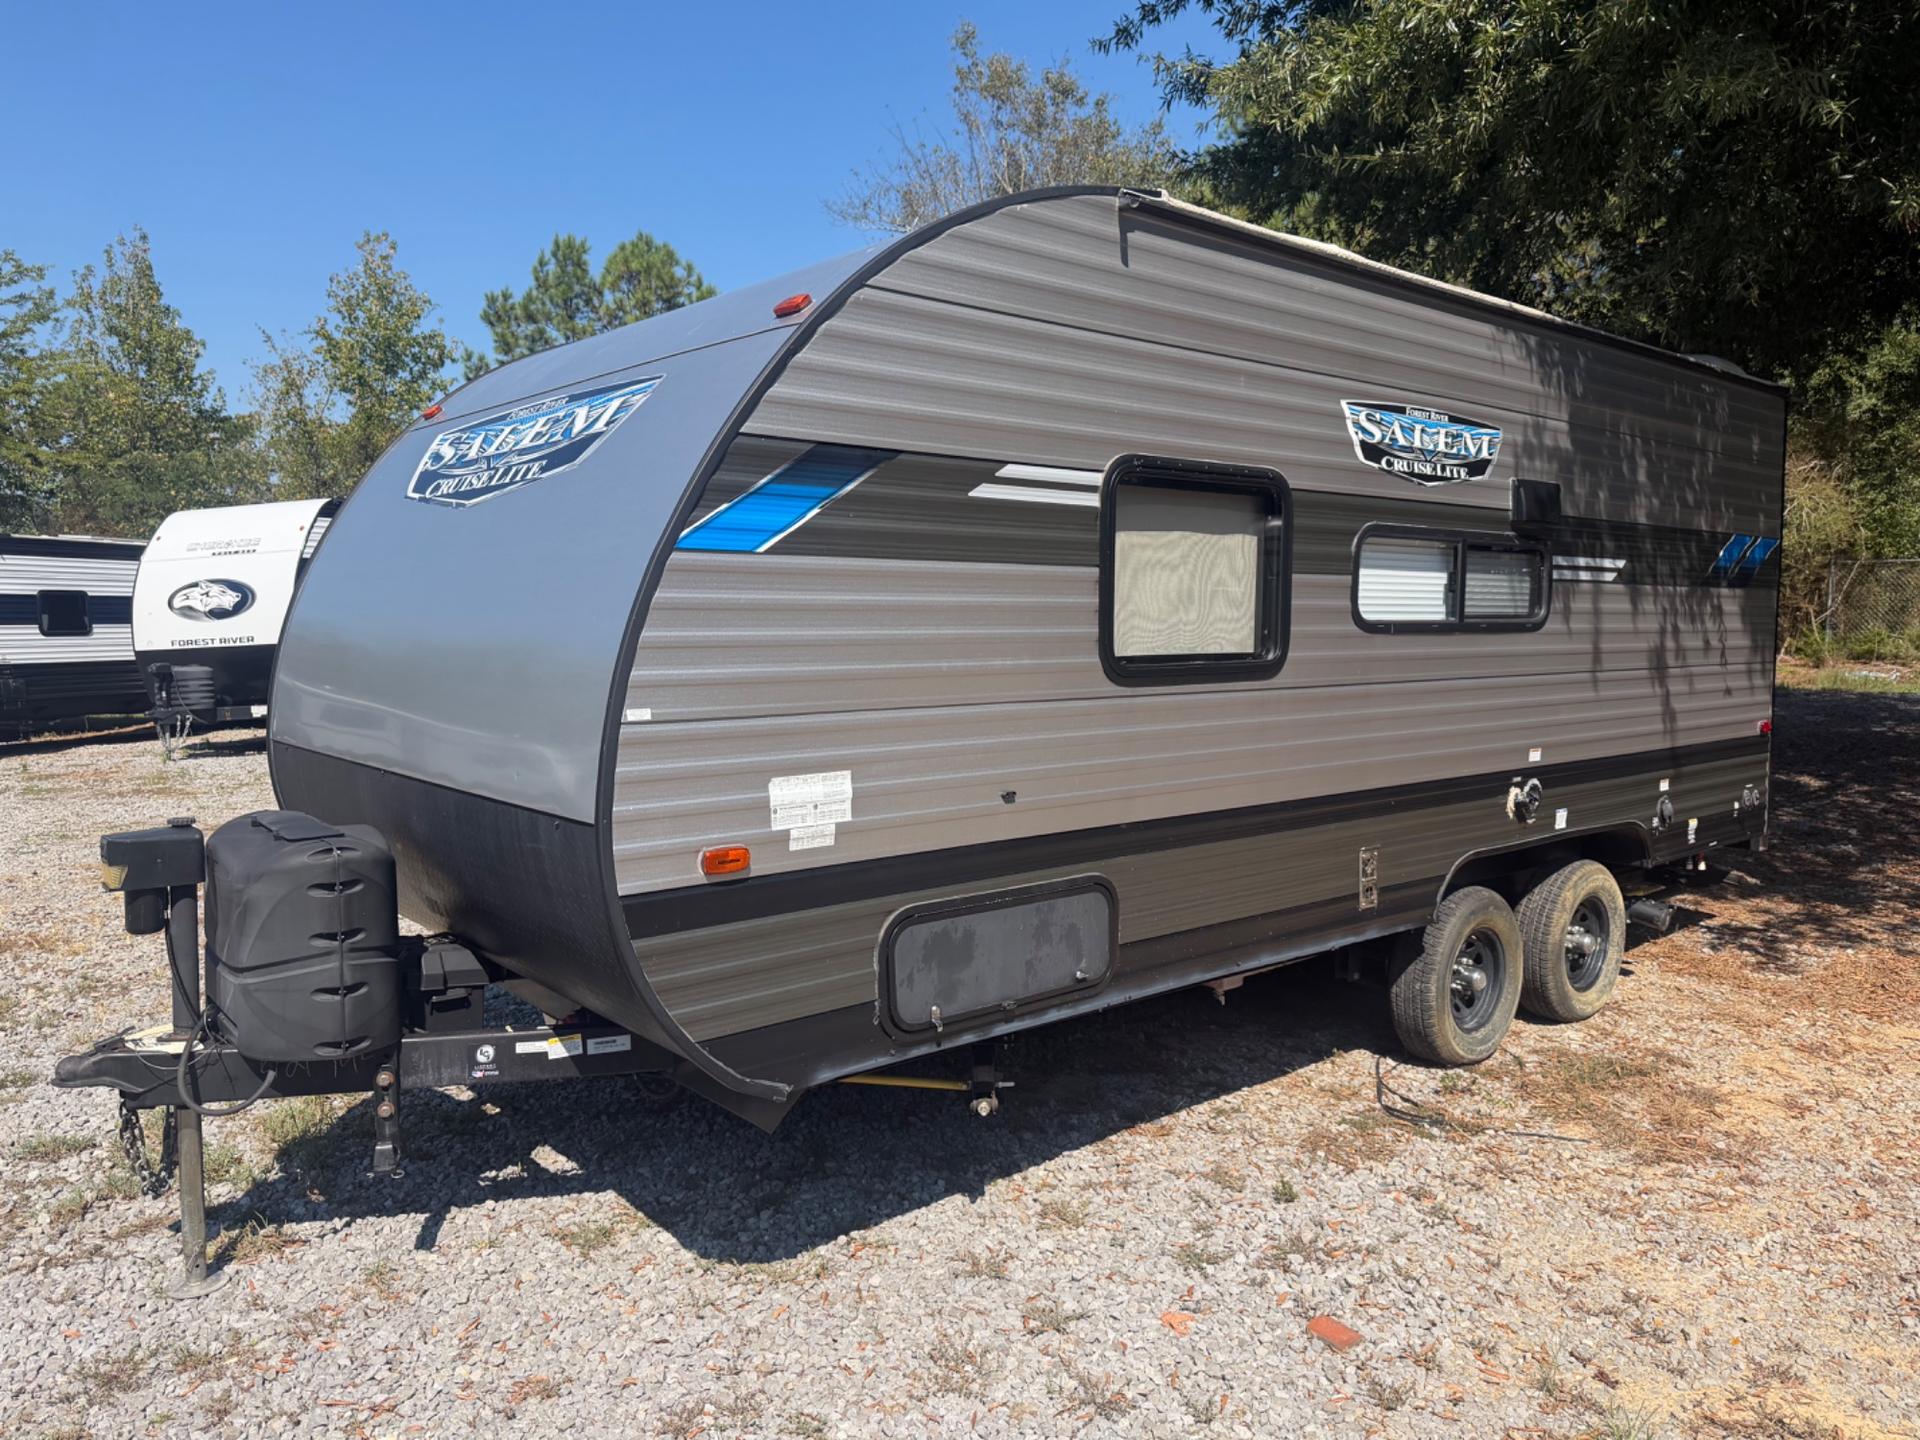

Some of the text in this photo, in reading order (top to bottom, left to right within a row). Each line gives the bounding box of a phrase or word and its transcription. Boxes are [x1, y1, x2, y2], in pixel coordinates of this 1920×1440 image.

[1405, 406, 1449, 422] FOREST RIVER
[424, 394, 634, 470] SALEM
[1357, 410, 1495, 459] SALEM
[170, 635, 255, 647] FOREST RIVER
